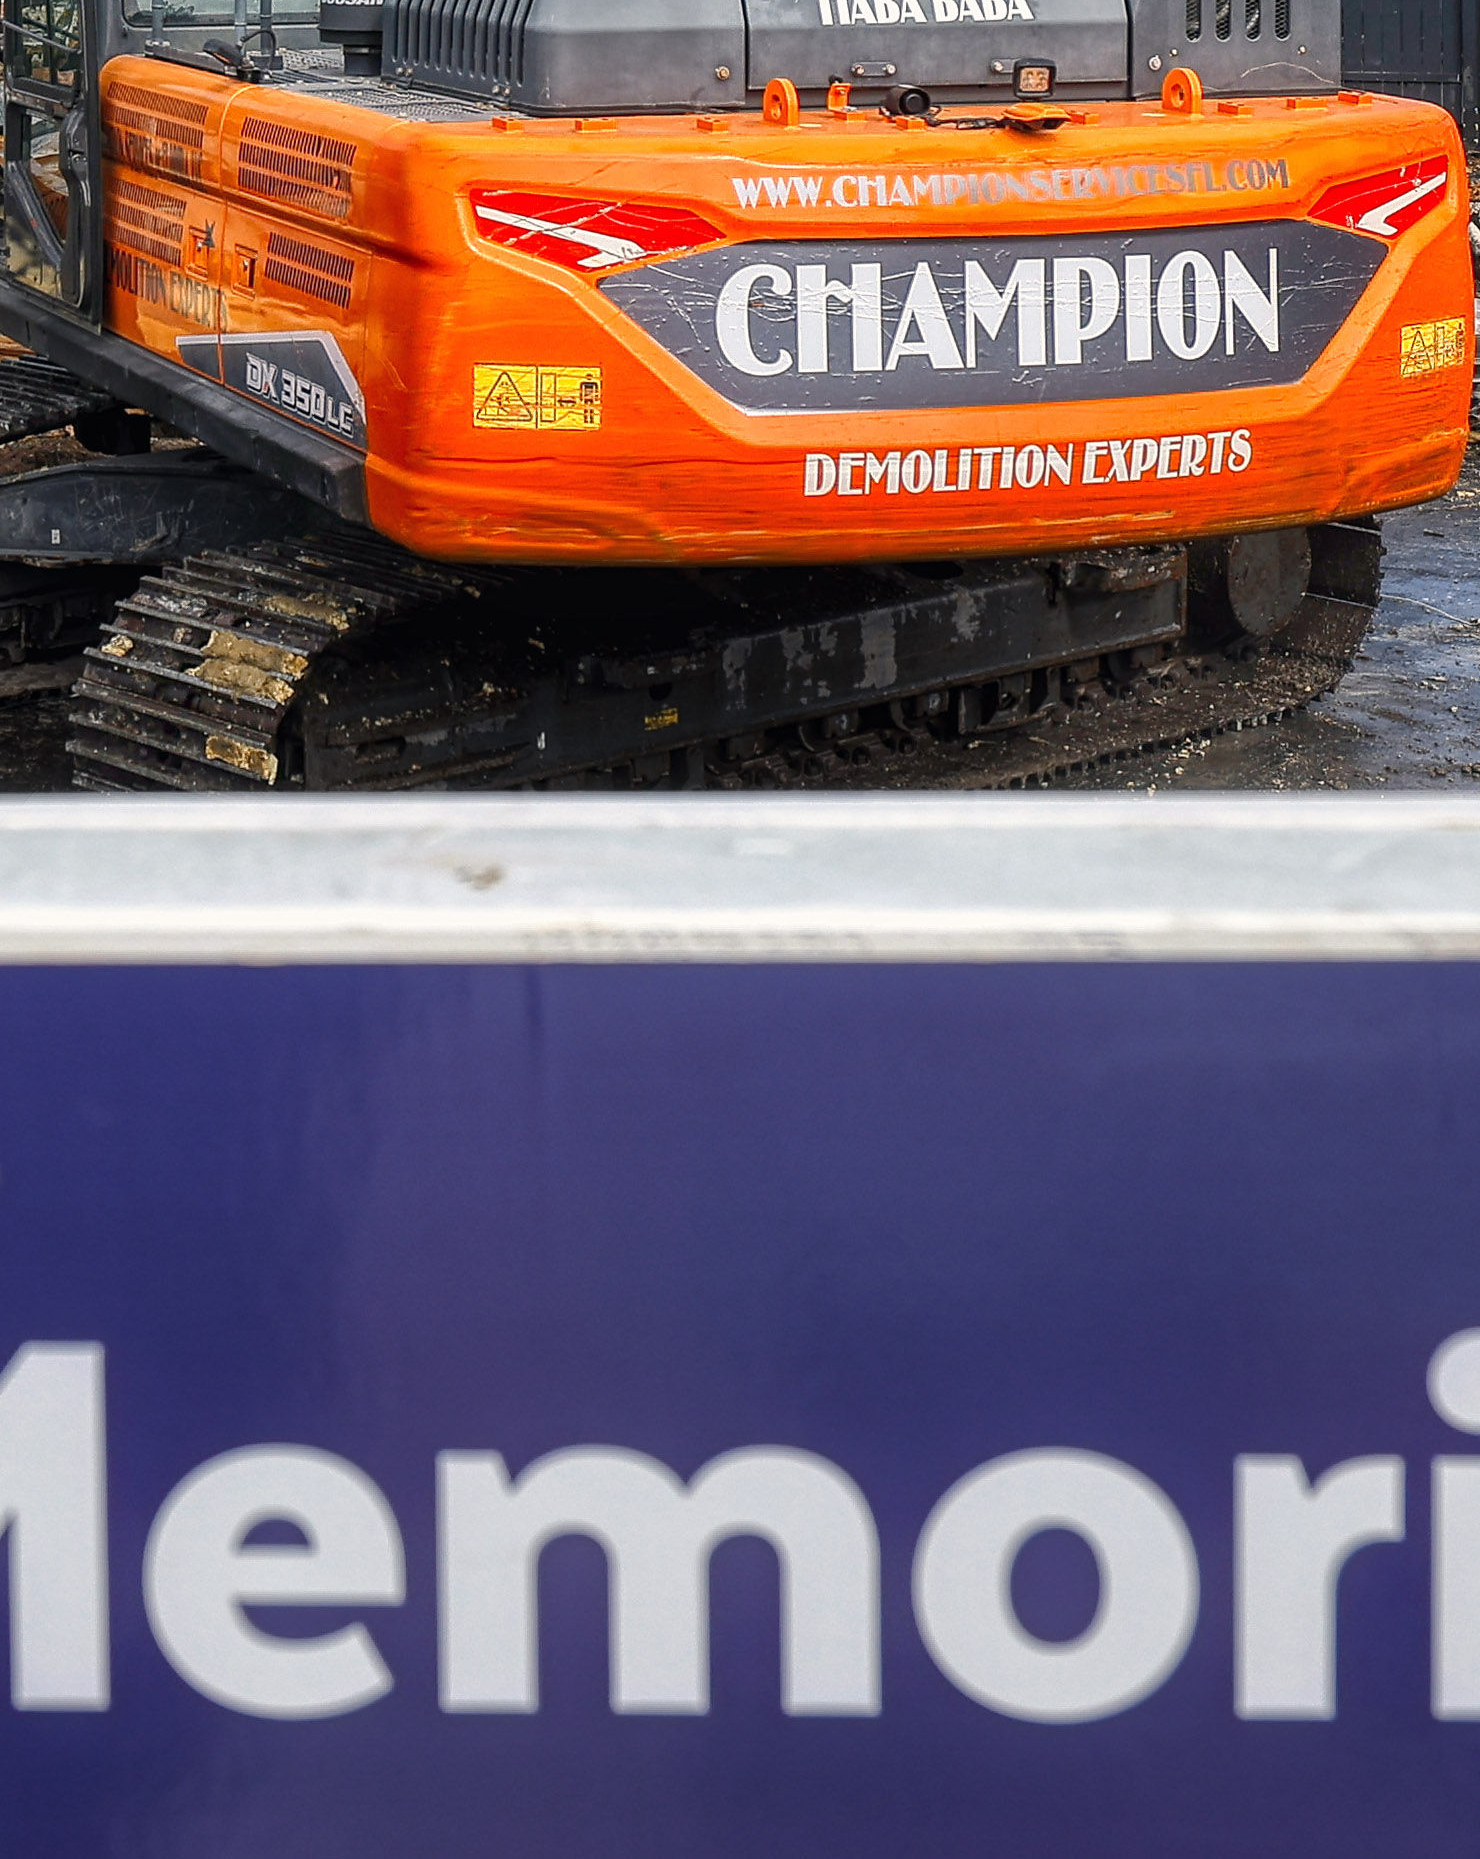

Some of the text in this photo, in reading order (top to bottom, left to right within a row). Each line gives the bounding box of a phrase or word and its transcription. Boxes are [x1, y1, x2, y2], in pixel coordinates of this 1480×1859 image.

[732, 159, 1288, 209] WWW.CHAMPIONSERVICESFL.COM
[716, 247, 1279, 377] CHAMPION
[803, 428, 1252, 497] DEMOLITION EXPERTS
